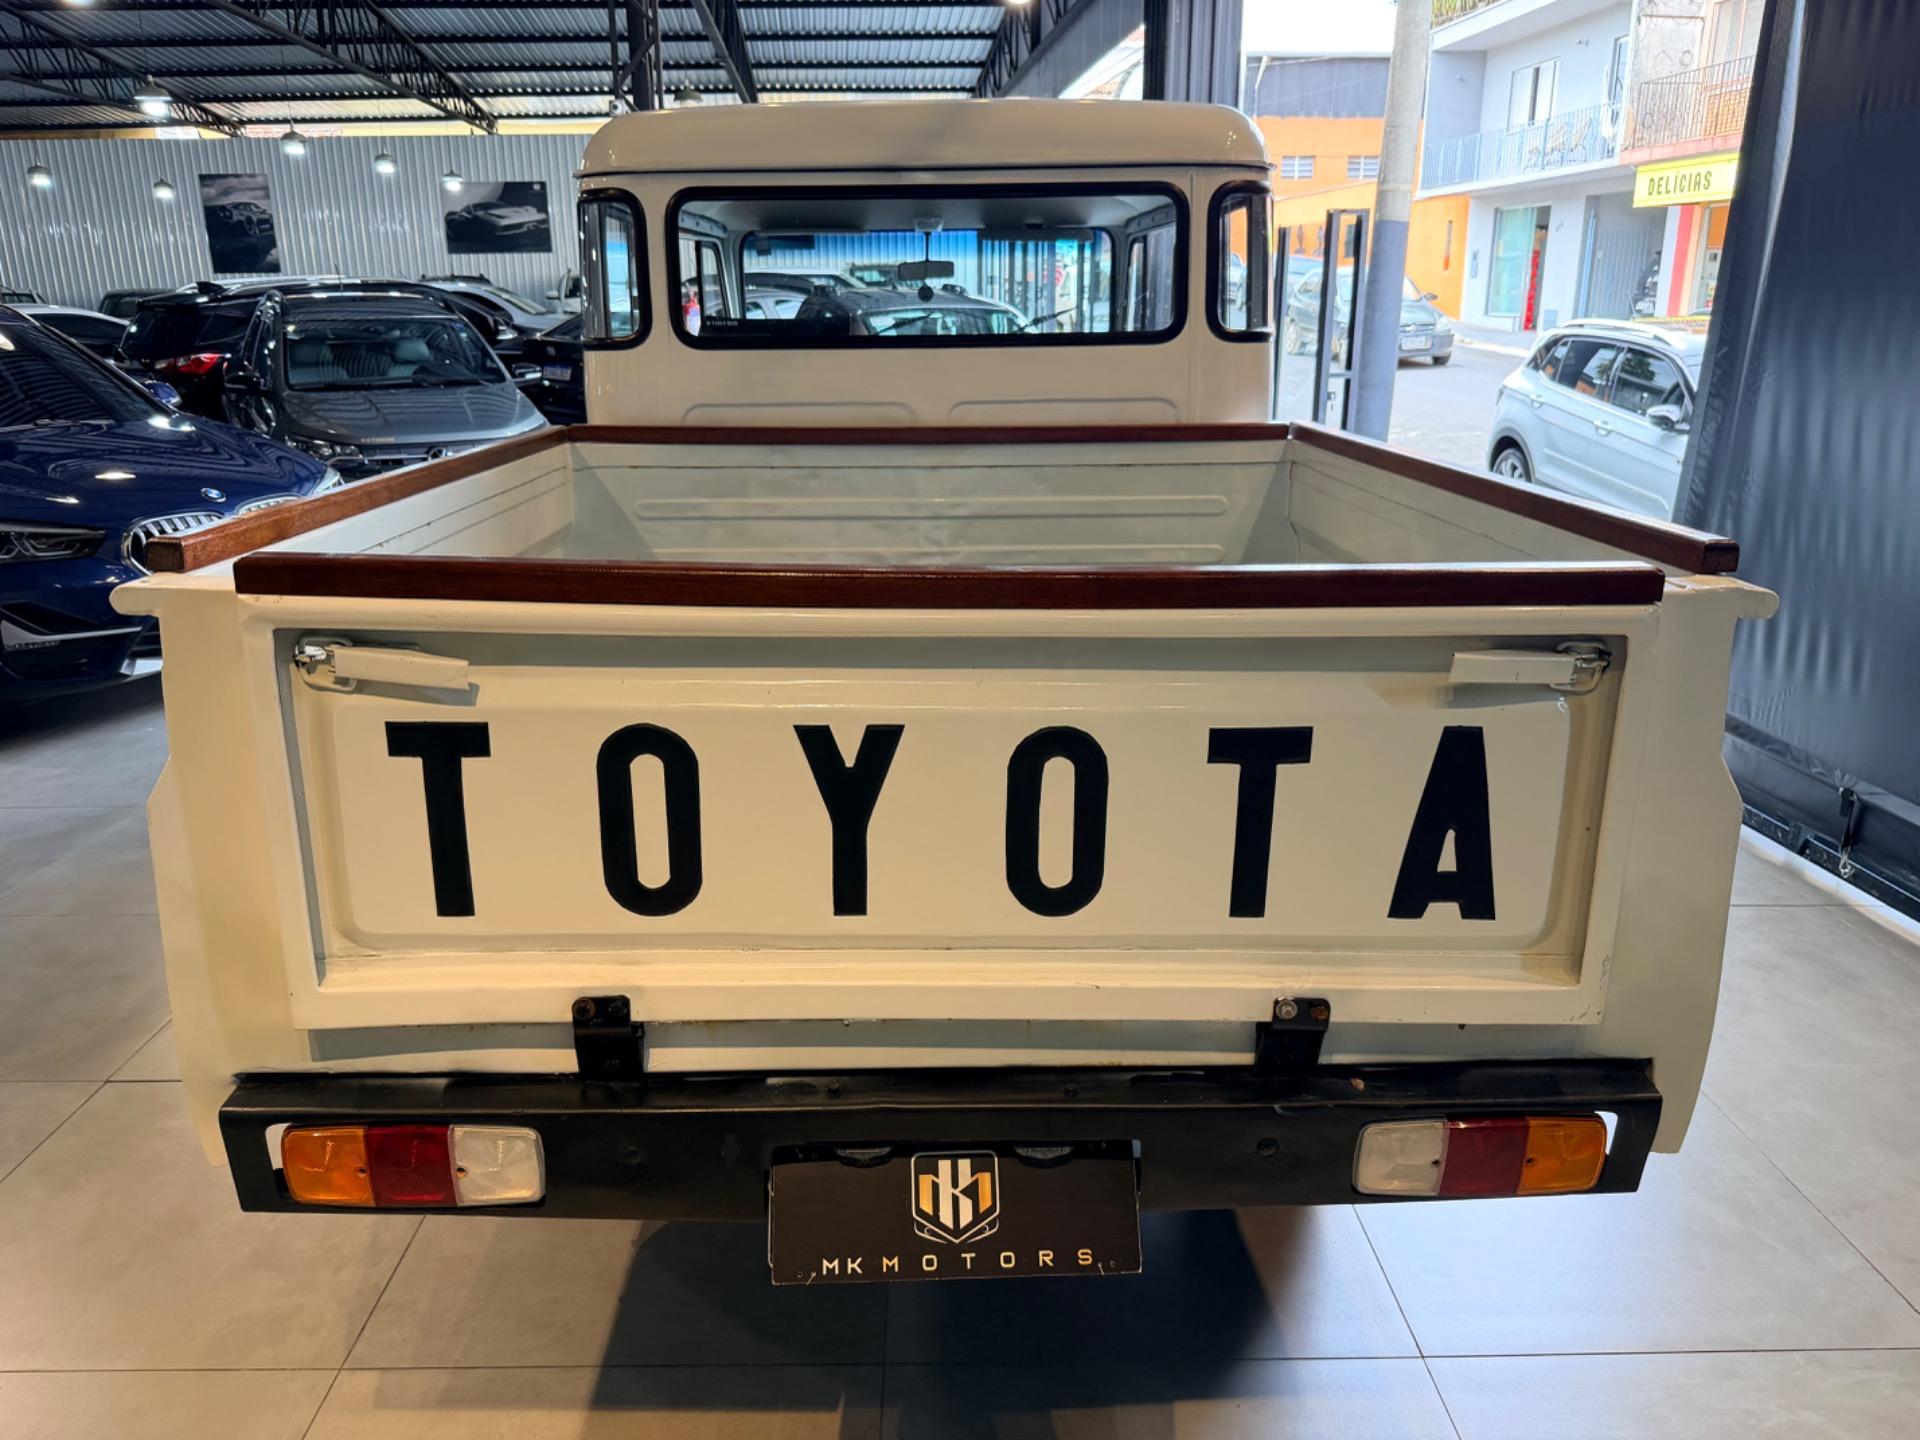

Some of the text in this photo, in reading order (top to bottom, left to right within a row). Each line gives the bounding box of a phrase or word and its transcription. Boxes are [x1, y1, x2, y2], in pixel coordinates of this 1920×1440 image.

[385, 721, 1496, 920] TOYOTA
[821, 1248, 1094, 1276] MK MOTORS
